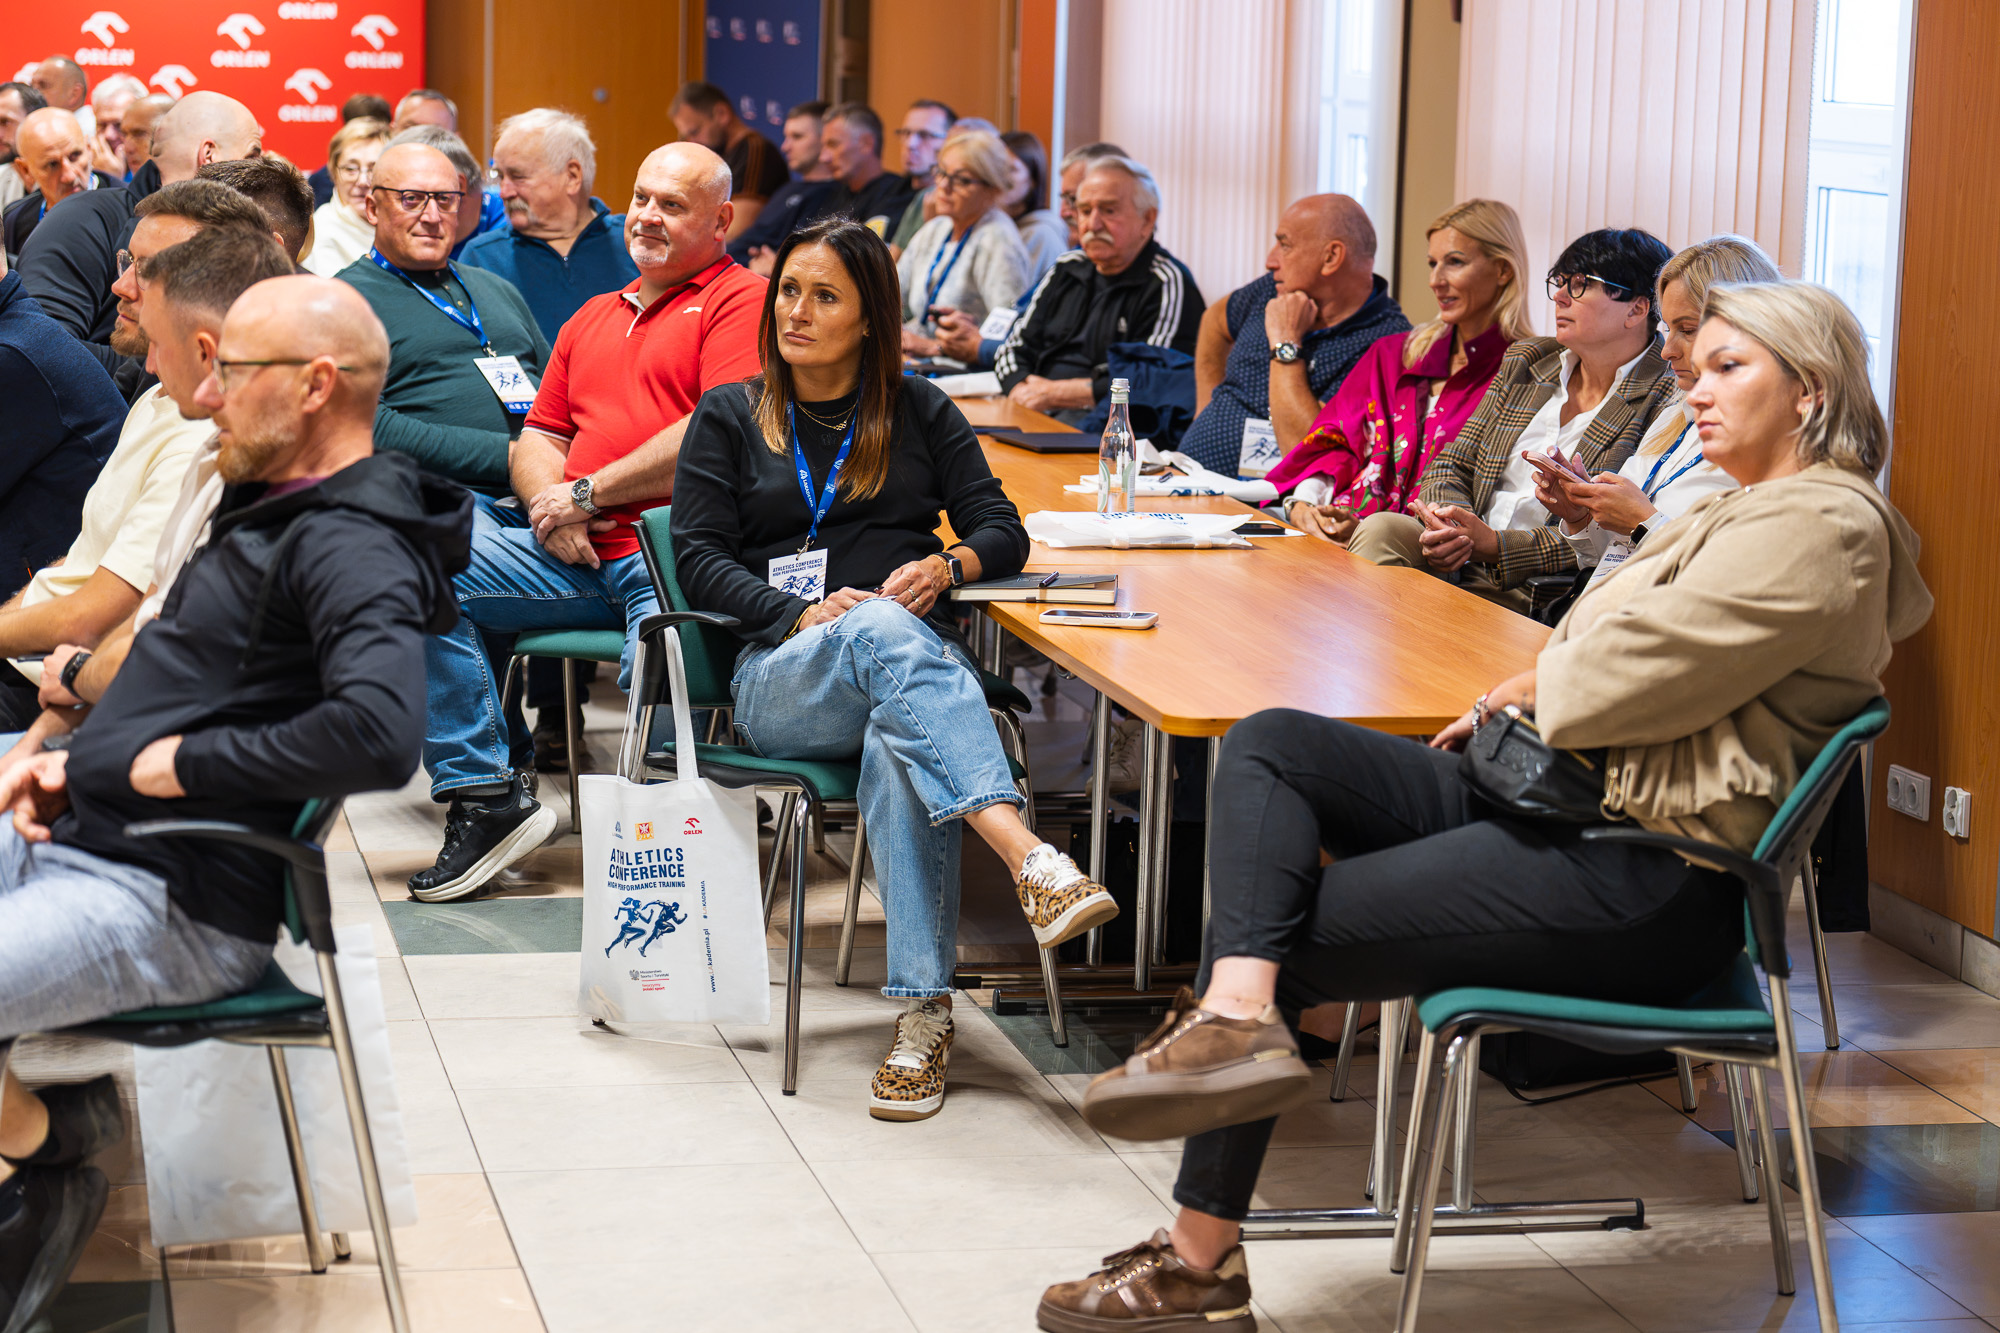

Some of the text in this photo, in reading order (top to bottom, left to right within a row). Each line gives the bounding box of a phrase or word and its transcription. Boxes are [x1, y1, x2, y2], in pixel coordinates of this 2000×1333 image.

[278, 1, 338, 20] ORLEN
[75, 47, 135, 67] ORLEN
[210, 49, 271, 68] ORLEN
[344, 50, 404, 69] ORLEN
[278, 104, 338, 122] ORLEN
[773, 558, 822, 572] ATHLETICS CONFERENCE
[610, 847, 684, 866] ATHLETICS
[608, 863, 685, 881] CONFERENCE
[607, 880, 686, 891] HIGH PERFORMANCE TRAINING
[703, 928, 717, 993] www.LAkademia.pl
